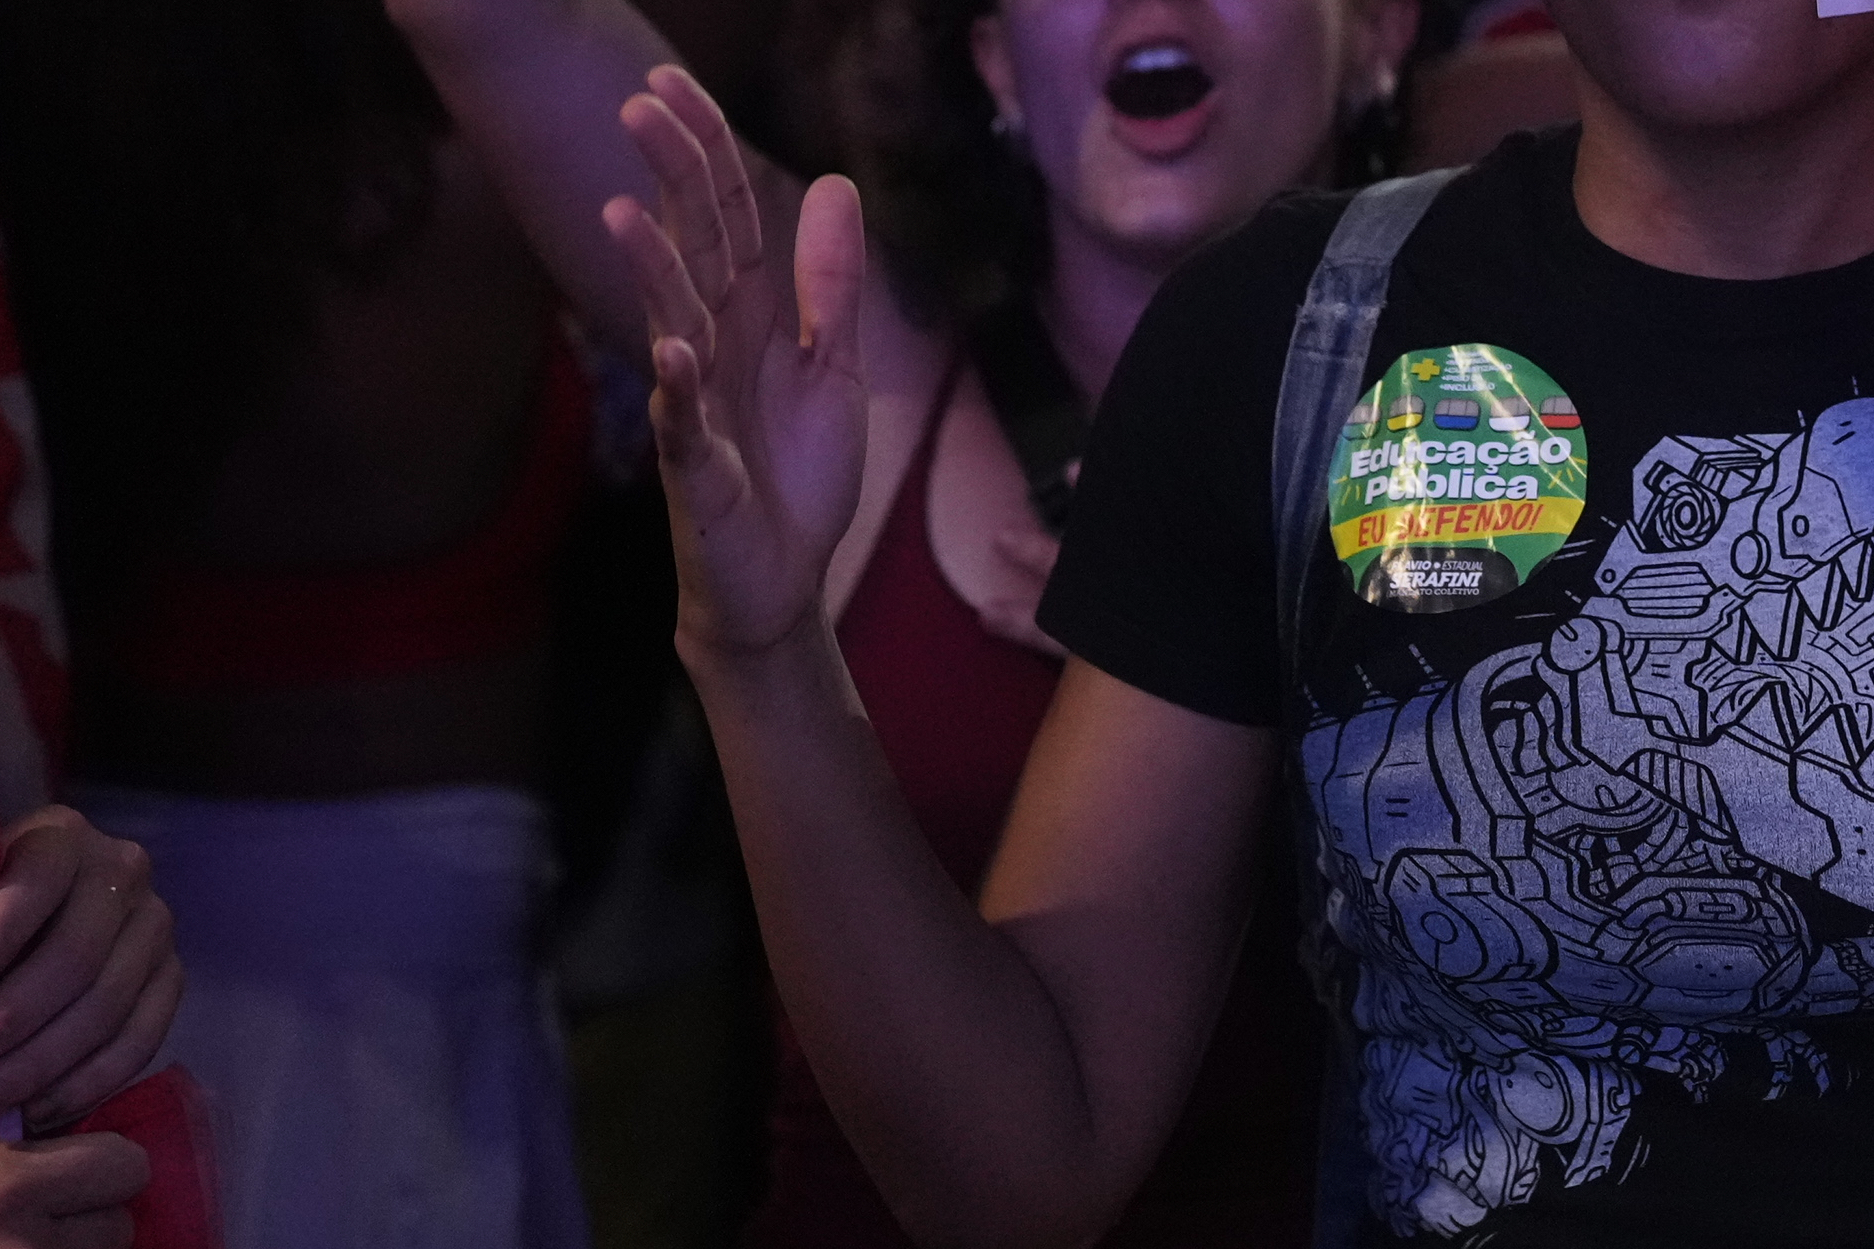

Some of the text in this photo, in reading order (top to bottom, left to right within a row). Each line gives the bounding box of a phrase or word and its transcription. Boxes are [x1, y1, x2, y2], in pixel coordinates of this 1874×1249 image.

[1350, 430, 1572, 478] Educação
[1358, 502, 1545, 547] EU DEFENDO!
[1441, 560, 1483, 571] ESTADUAL
[1389, 571, 1483, 590] SERAFINI
[1434, 587, 1480, 597] COLETIVO
